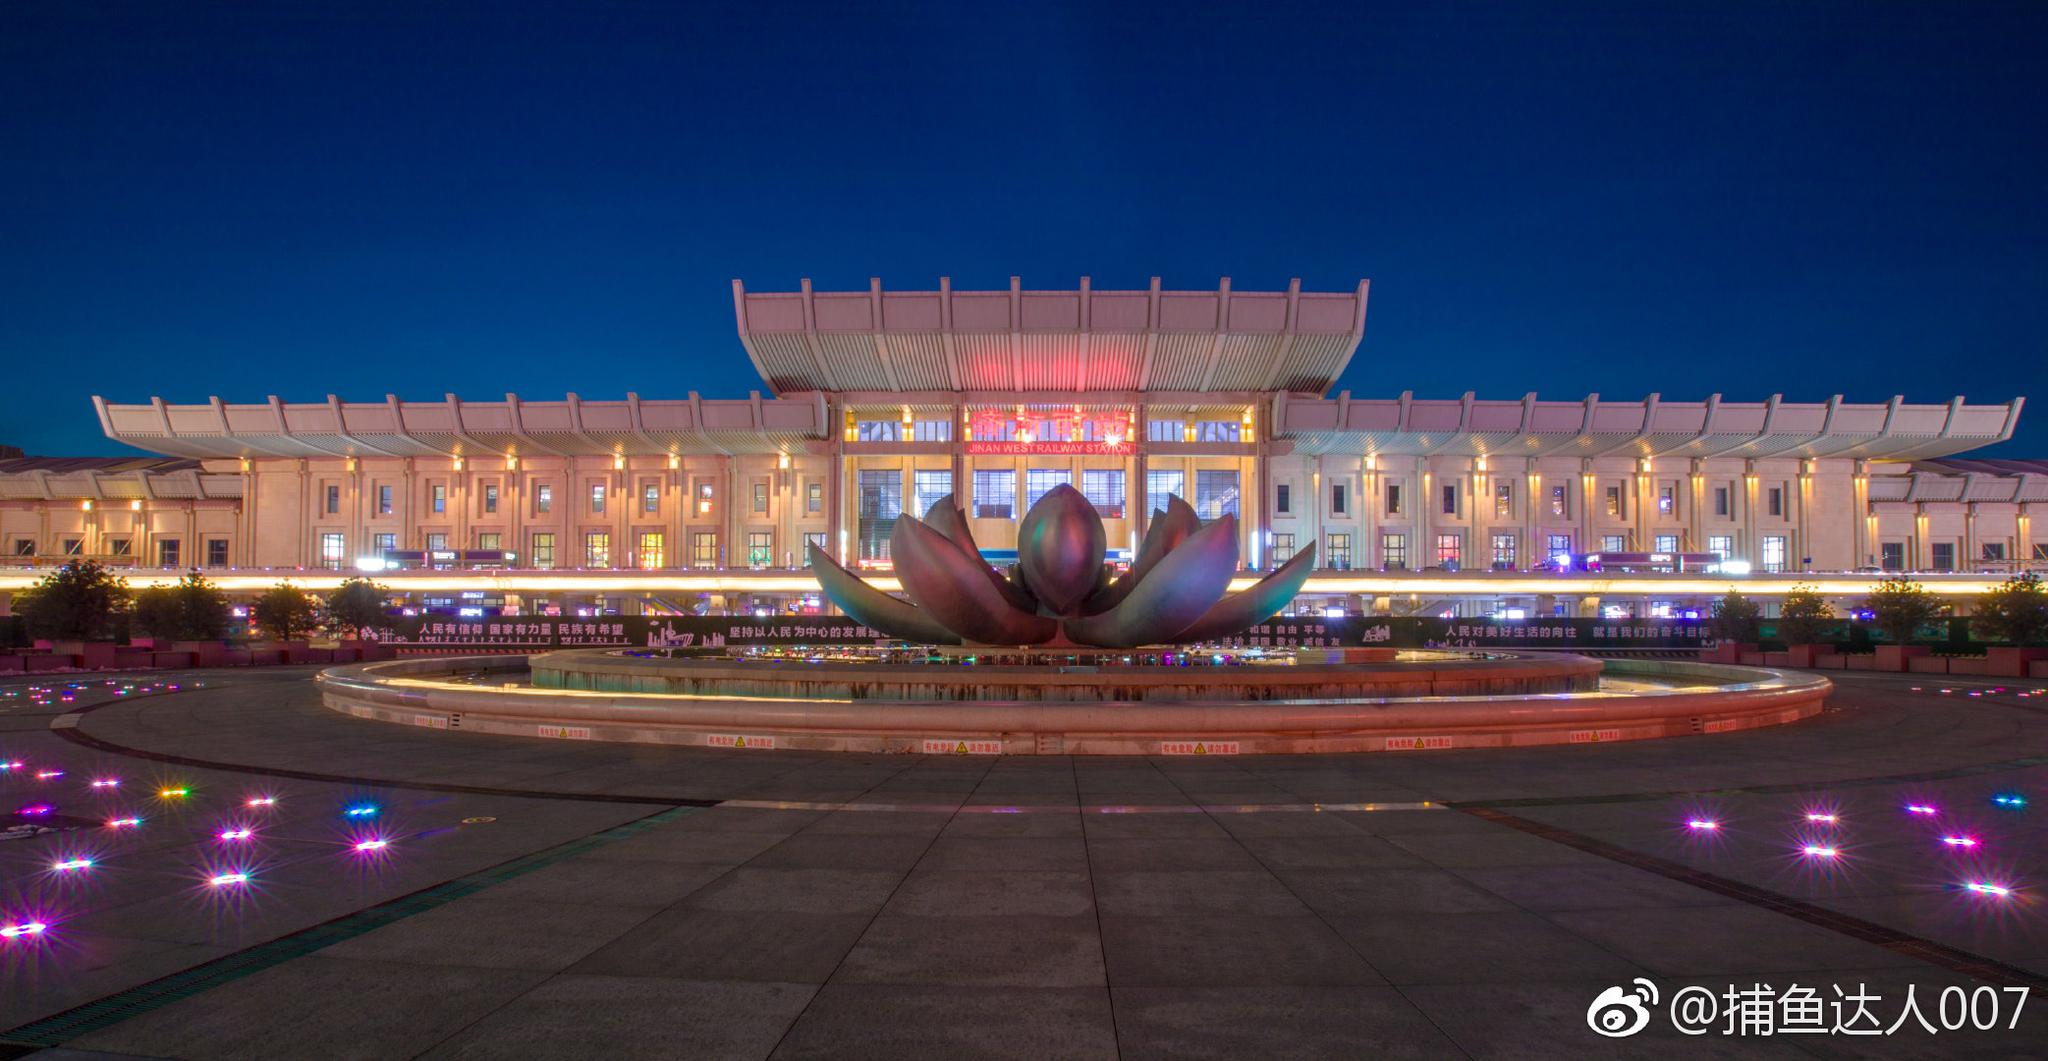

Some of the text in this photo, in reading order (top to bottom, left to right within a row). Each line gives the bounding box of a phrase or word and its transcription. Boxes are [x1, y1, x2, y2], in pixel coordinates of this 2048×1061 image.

[969, 444, 1000, 454] JINAN
[1003, 444, 1034, 454] WEST
[1037, 444, 1084, 454] RAILWAY
[419, 623, 624, 636] 人民有信仰 国家有力量 民族有希望
[729, 626, 890, 638] 坚持以人民为中心的发展理
[1276, 624, 1297, 635] 自由
[1304, 624, 1325, 635] 平等
[1445, 625, 1711, 638] 人民对美好生活的向往 就是我们的奋斗目标
